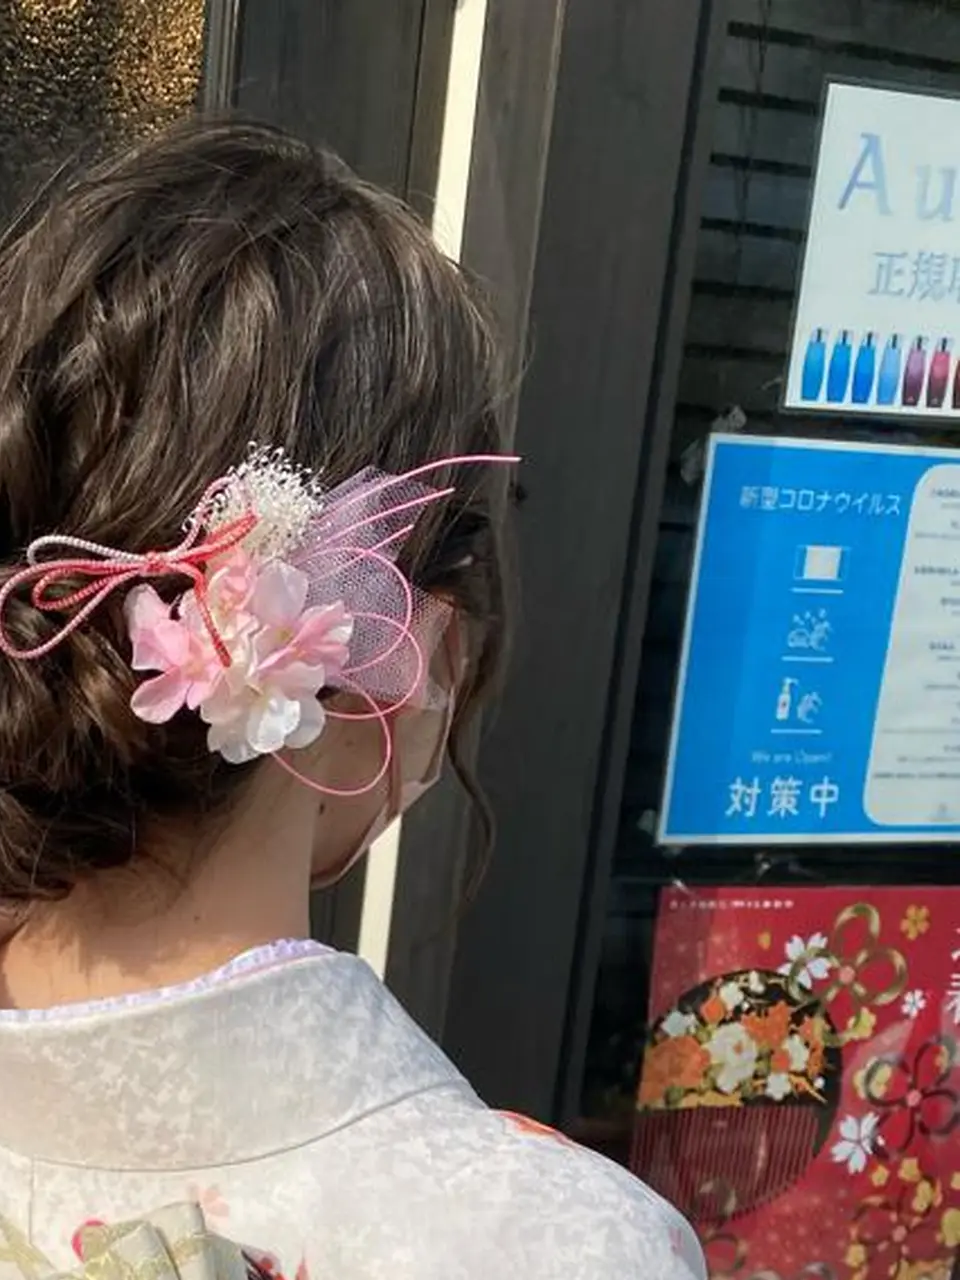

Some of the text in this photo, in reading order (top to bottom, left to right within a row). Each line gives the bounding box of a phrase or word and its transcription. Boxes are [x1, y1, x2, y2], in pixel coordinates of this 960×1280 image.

[740, 485, 900, 516] 新型コロナウイルス
[724, 774, 839, 820] 対策中
